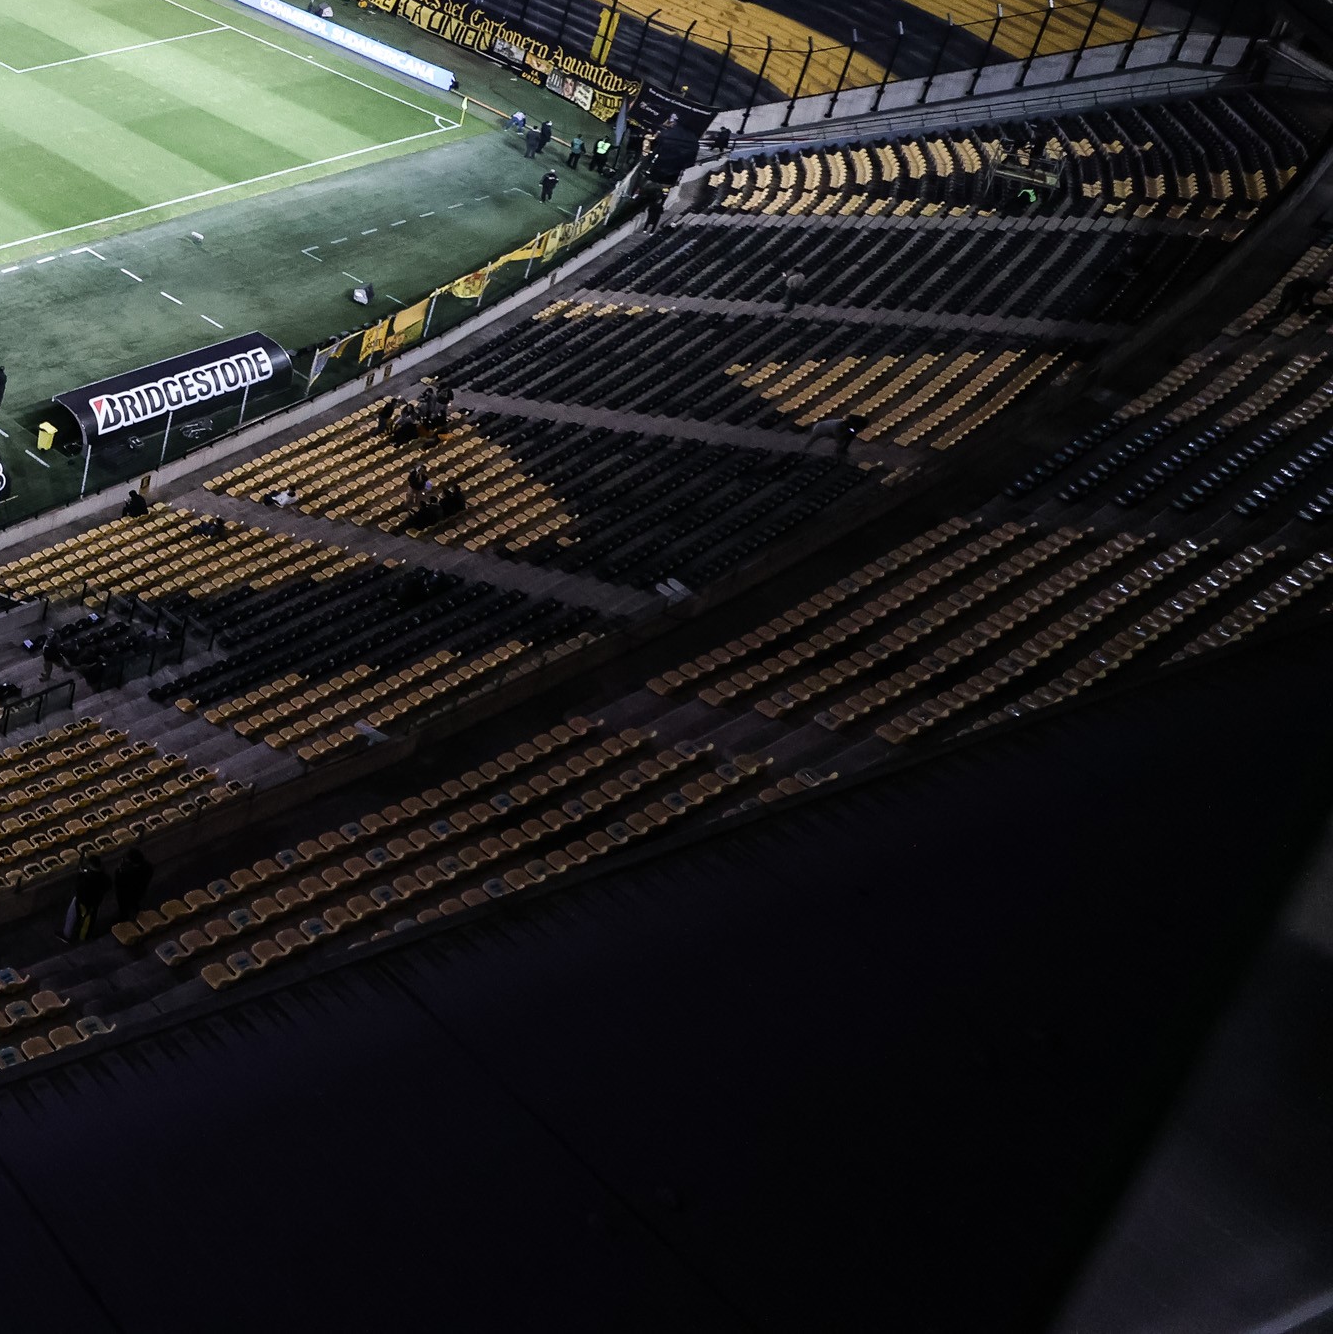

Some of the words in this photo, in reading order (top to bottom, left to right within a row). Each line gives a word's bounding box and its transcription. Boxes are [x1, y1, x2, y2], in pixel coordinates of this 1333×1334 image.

[333, 26, 436, 84] SUDAMERICANA
[428, 9, 492, 53] UNION
[469, 9, 550, 62] Carbonero
[548, 44, 623, 93] Aguantan
[88, 346, 275, 436] BRIDGESTONE
